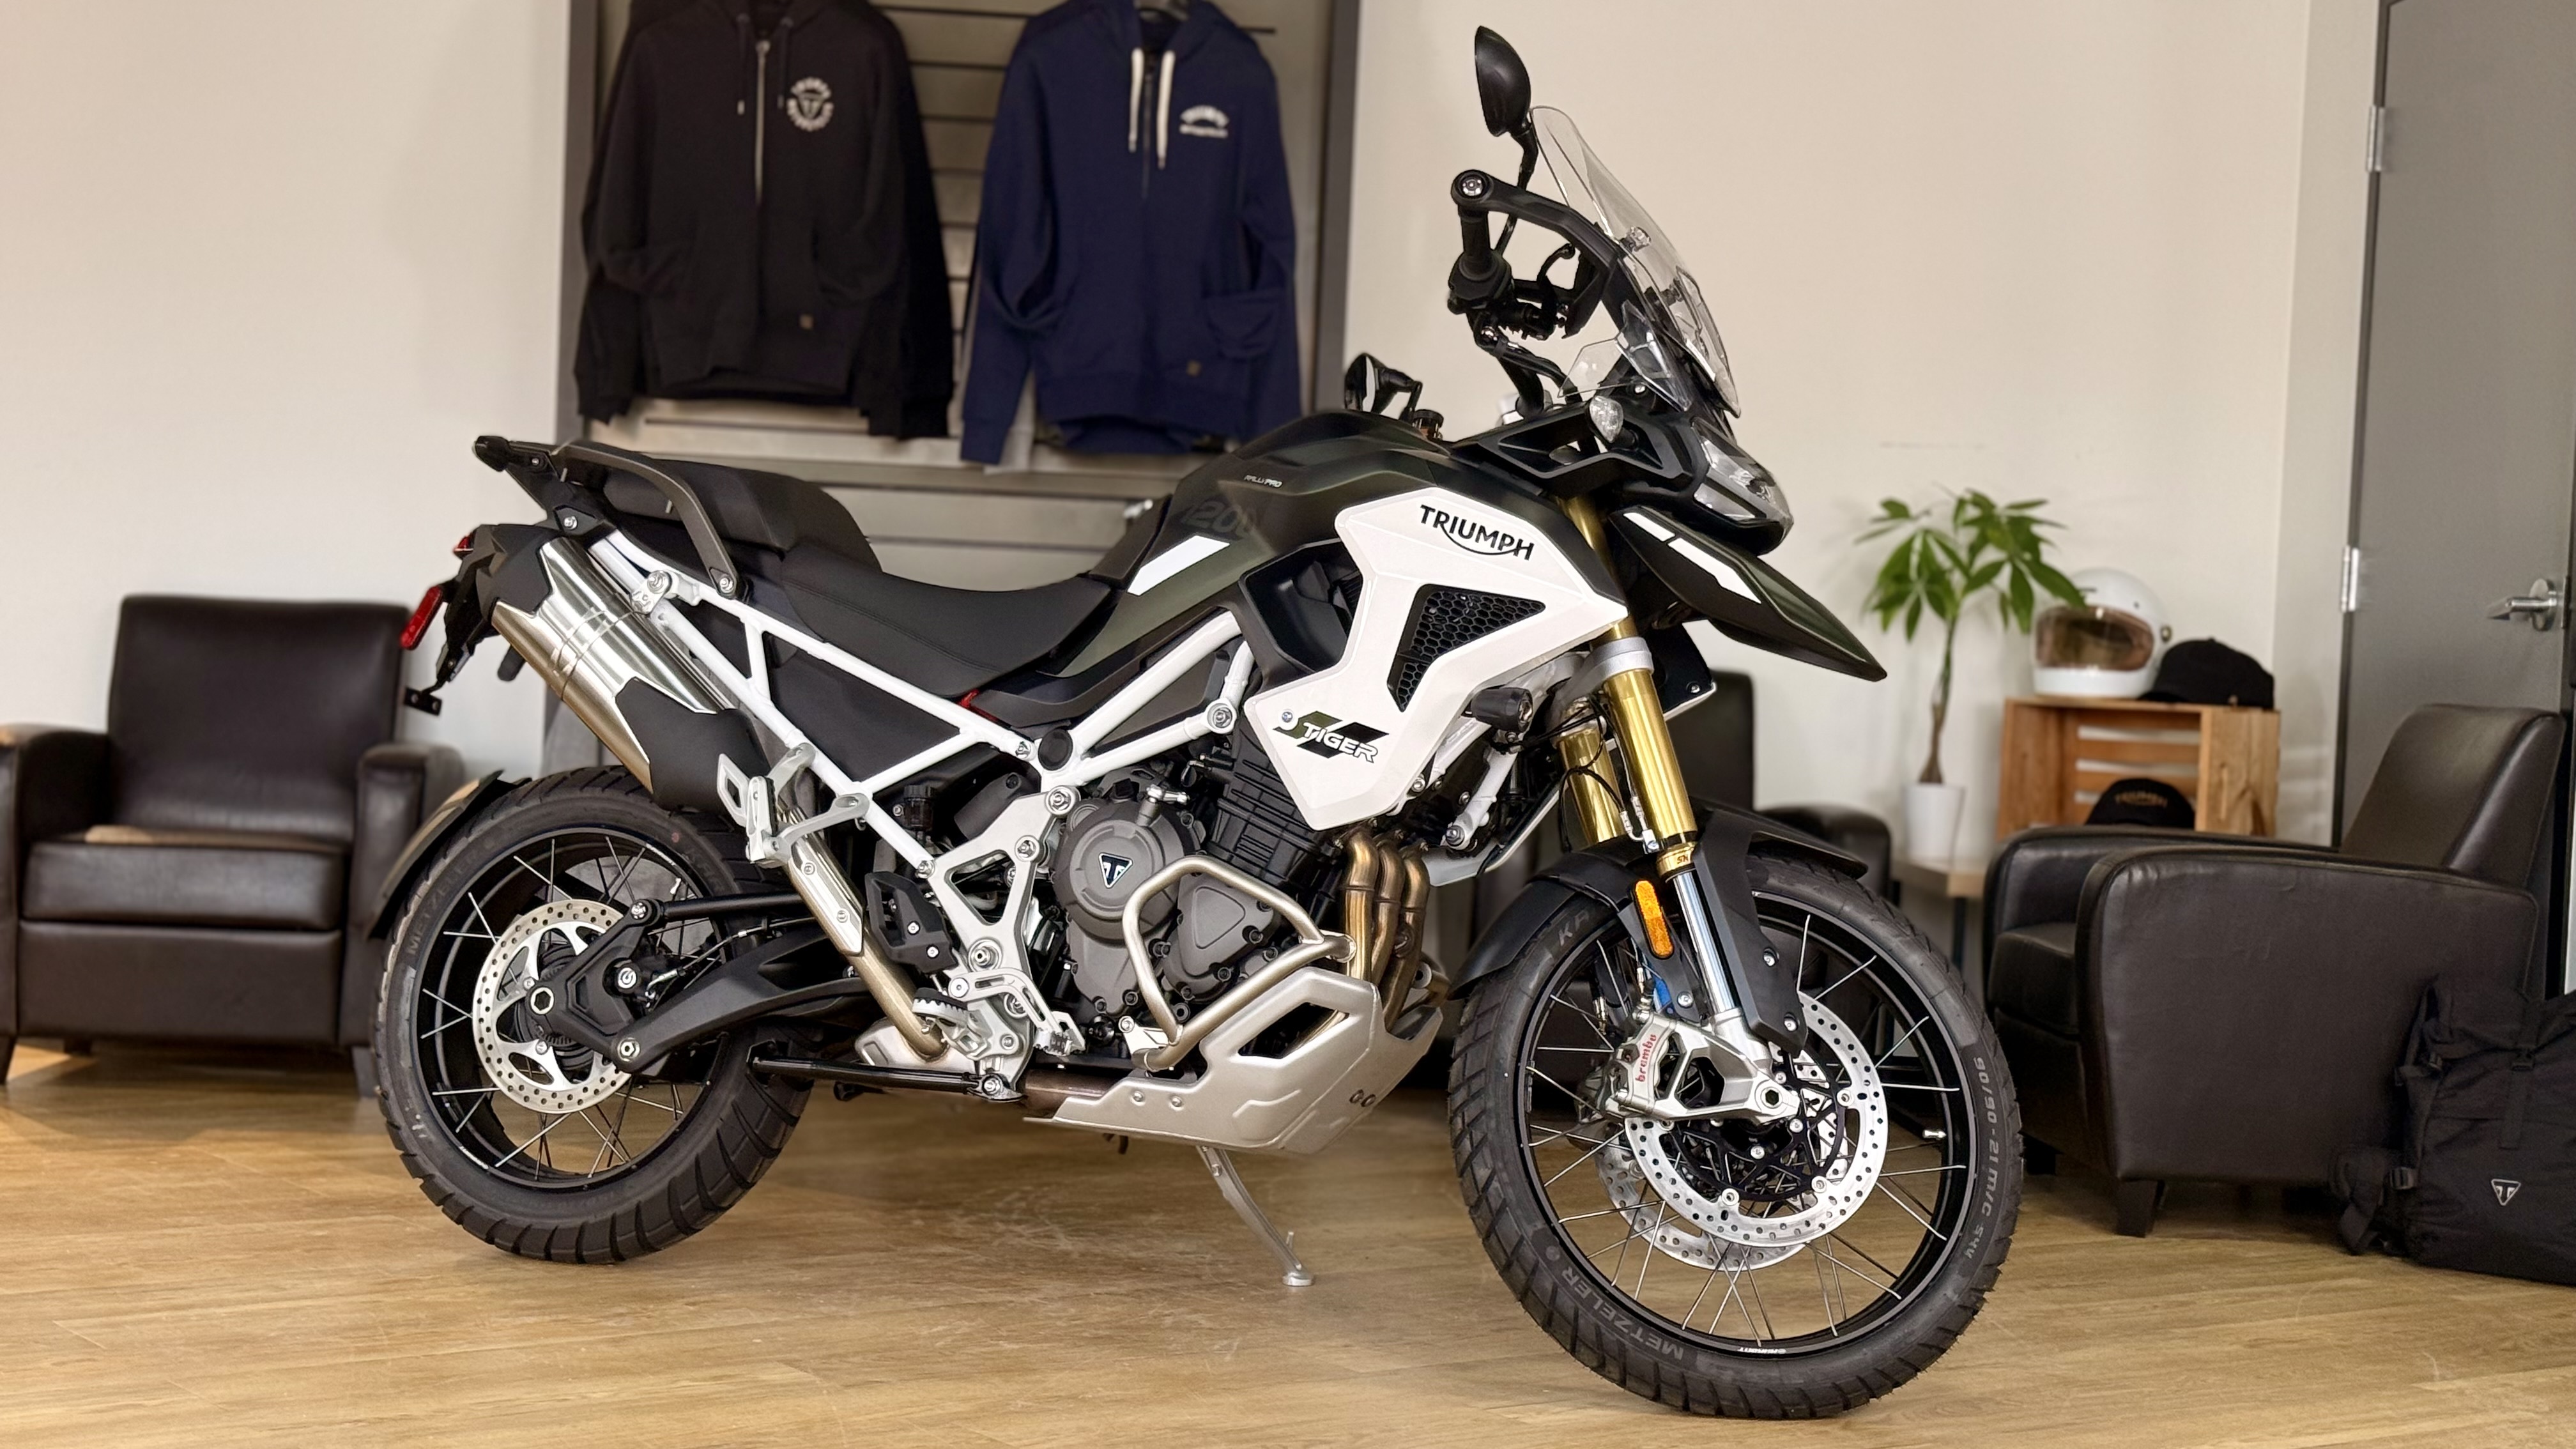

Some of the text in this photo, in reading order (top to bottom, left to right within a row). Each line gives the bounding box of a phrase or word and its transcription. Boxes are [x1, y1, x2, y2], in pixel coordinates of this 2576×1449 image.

[1264, 479, 1283, 487] PRO
[1420, 504, 1535, 560] TRIUMPH
[1303, 722, 1379, 763] TIGER
[1635, 1034, 1657, 1082] brembo
[1561, 1266, 1684, 1360] METZELER
